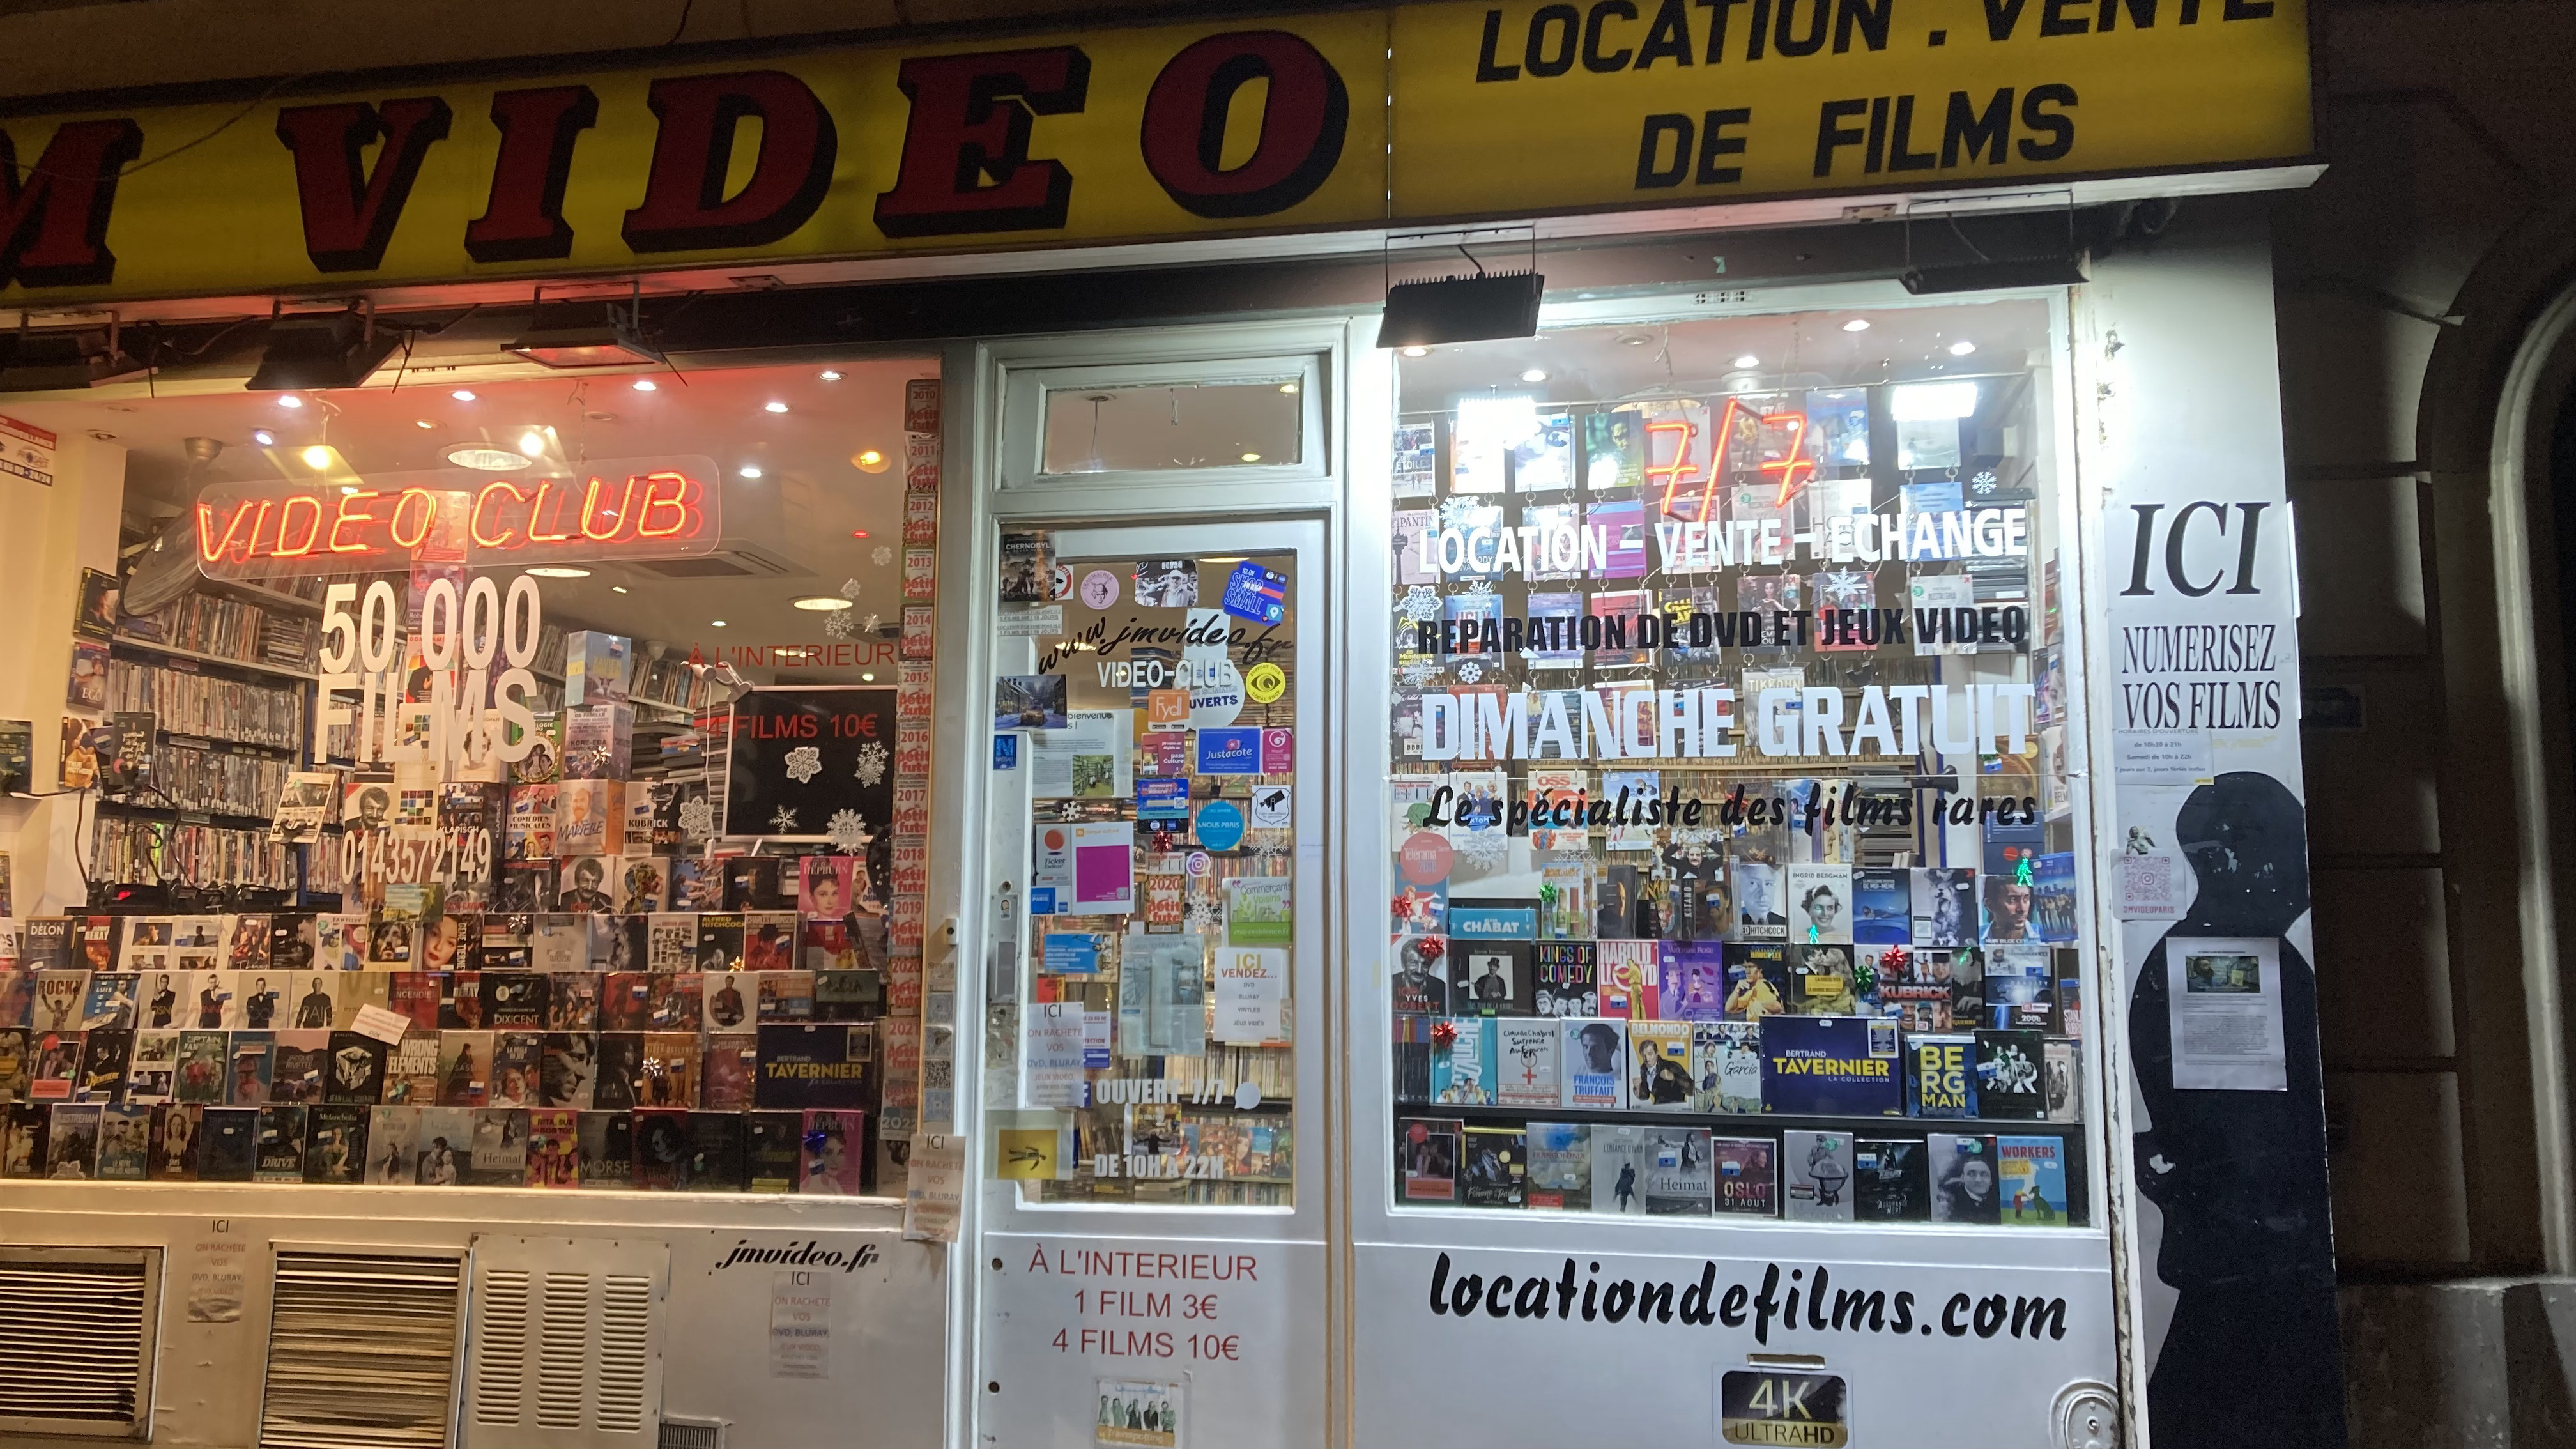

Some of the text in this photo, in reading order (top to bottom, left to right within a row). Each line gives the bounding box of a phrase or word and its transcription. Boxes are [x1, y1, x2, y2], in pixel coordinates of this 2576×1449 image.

[1476, 0, 2274, 82] LOCATION VEN
[1635, 84, 2080, 190] DE FILMS
[275, 29, 1349, 272] VIDEO
[1645, 397, 1815, 524] 7/7
[909, 501, 934, 511] 2012
[197, 471, 688, 562] VIDEO CLUB
[1419, 509, 2028, 573] LOCATION VENTE ECHANGE
[2120, 501, 2271, 597] ICI
[907, 557, 933, 568] 2013
[1229, 572, 1264, 594] SHOP
[1223, 589, 1265, 615] SMALL
[319, 575, 540, 674] 50 000
[906, 615, 931, 625] 2014
[1418, 605, 2026, 655] REPARATION DE DVD ET JEUX VIDEO
[1038, 614, 1295, 675] www.jmvideo.fr
[2122, 624, 2277, 674] NUMERISEZ
[715, 642, 896, 669] L'INTERIEUR
[903, 672, 930, 683] 2015
[1097, 659, 1236, 689] VIDEO-CLUB
[82, 687, 102, 702] EGO
[1188, 694, 1238, 710] UVERTS
[2122, 680, 2281, 729] VOS FILMS
[314, 668, 537, 763] FILMS
[1422, 683, 2036, 761] DIMANCHE GRATUIT
[733, 714, 819, 739] FILMS
[829, 713, 878, 738] 10€
[900, 732, 928, 742] 2016
[1206, 747, 1253, 760] Justacote
[897, 790, 926, 801] 2017
[1423, 782, 2037, 837] Le spécialiste des films rares
[509, 822, 551, 830] MUSICALES
[512, 815, 549, 824] COMÉDIES
[627, 818, 669, 828] KUBRICK
[342, 828, 491, 884] 0143572149
[895, 848, 925, 861] 2018
[1404, 847, 1437, 861] Télérama
[803, 866, 848, 875] HEPBURN
[1149, 878, 1181, 891] 2020
[1240, 881, 1292, 896] Commerçants
[1253, 894, 1282, 905] Voisins
[894, 901, 922, 914] 2019
[746, 915, 795, 924] CHARLES BRONSON
[30, 924, 65, 935] DELON
[1749, 926, 1786, 935] HITCHCOCK
[1539, 945, 1593, 963] KINGS OF
[1600, 942, 1652, 965] HAROLD
[891, 961, 921, 974] 2020
[1235, 953, 1262, 970] ICI
[1540, 965, 1593, 984] COMEDY
[36, 980, 84, 995] ROCKY
[1880, 985, 1951, 999] KUBRICK
[1043, 1004, 1062, 1018] ICI
[1027, 1028, 1083, 1038] ON RACHETE
[1630, 1023, 1690, 1036] BELMONDO
[401, 1039, 439, 1057] WRONG
[1046, 1043, 1065, 1052] VOS
[1785, 1050, 1827, 1058] BERTRAND
[388, 1055, 438, 1075] ELEMENTS
[1919, 1046, 1965, 1071] BE
[765, 1062, 863, 1080] TAVERNIER
[1724, 1062, 1758, 1077] Garcia
[1772, 1057, 1889, 1077] TAVERNIER
[1921, 1071, 1966, 1094] RG
[1096, 1078, 1178, 1105] OUVERT
[1191, 1078, 1225, 1105] 7/7
[1574, 1086, 1615, 1096] TRUFFAUT
[1922, 1093, 1966, 1108] MAN
[319, 1112, 358, 1122] Melancholia
[926, 1135, 945, 1150] ICI
[261, 1157, 296, 1169] DRIVE
[482, 1153, 522, 1165] Heimat
[1093, 1153, 1120, 1178] DE
[1123, 1154, 1162, 1179] 10H
[1165, 1155, 1179, 1177] A
[579, 1160, 631, 1175] MORSE
[928, 1175, 946, 1185] VOS
[1660, 1177, 1708, 1192] Heimat
[1724, 1198, 1736, 1208] 31
[211, 1219, 229, 1233] ICI
[195, 1243, 208, 1252] ON
[715, 1239, 880, 1273] jmvideo.fr
[1029, 1243, 1259, 1282] À L'INTERIEUR
[792, 1271, 811, 1287] ICI
[774, 1296, 831, 1307] ON RACHETE
[1074, 1289, 1218, 1320] 1 FILM 3€
[1429, 1252, 2067, 1346] locationdefilms.com
[792, 1312, 811, 1321] VOS
[1052, 1328, 1240, 1361] 4 FILMS 10€
[1749, 1379, 1814, 1421] 4K
[1733, 1421, 1835, 1446] ULTRAHD
